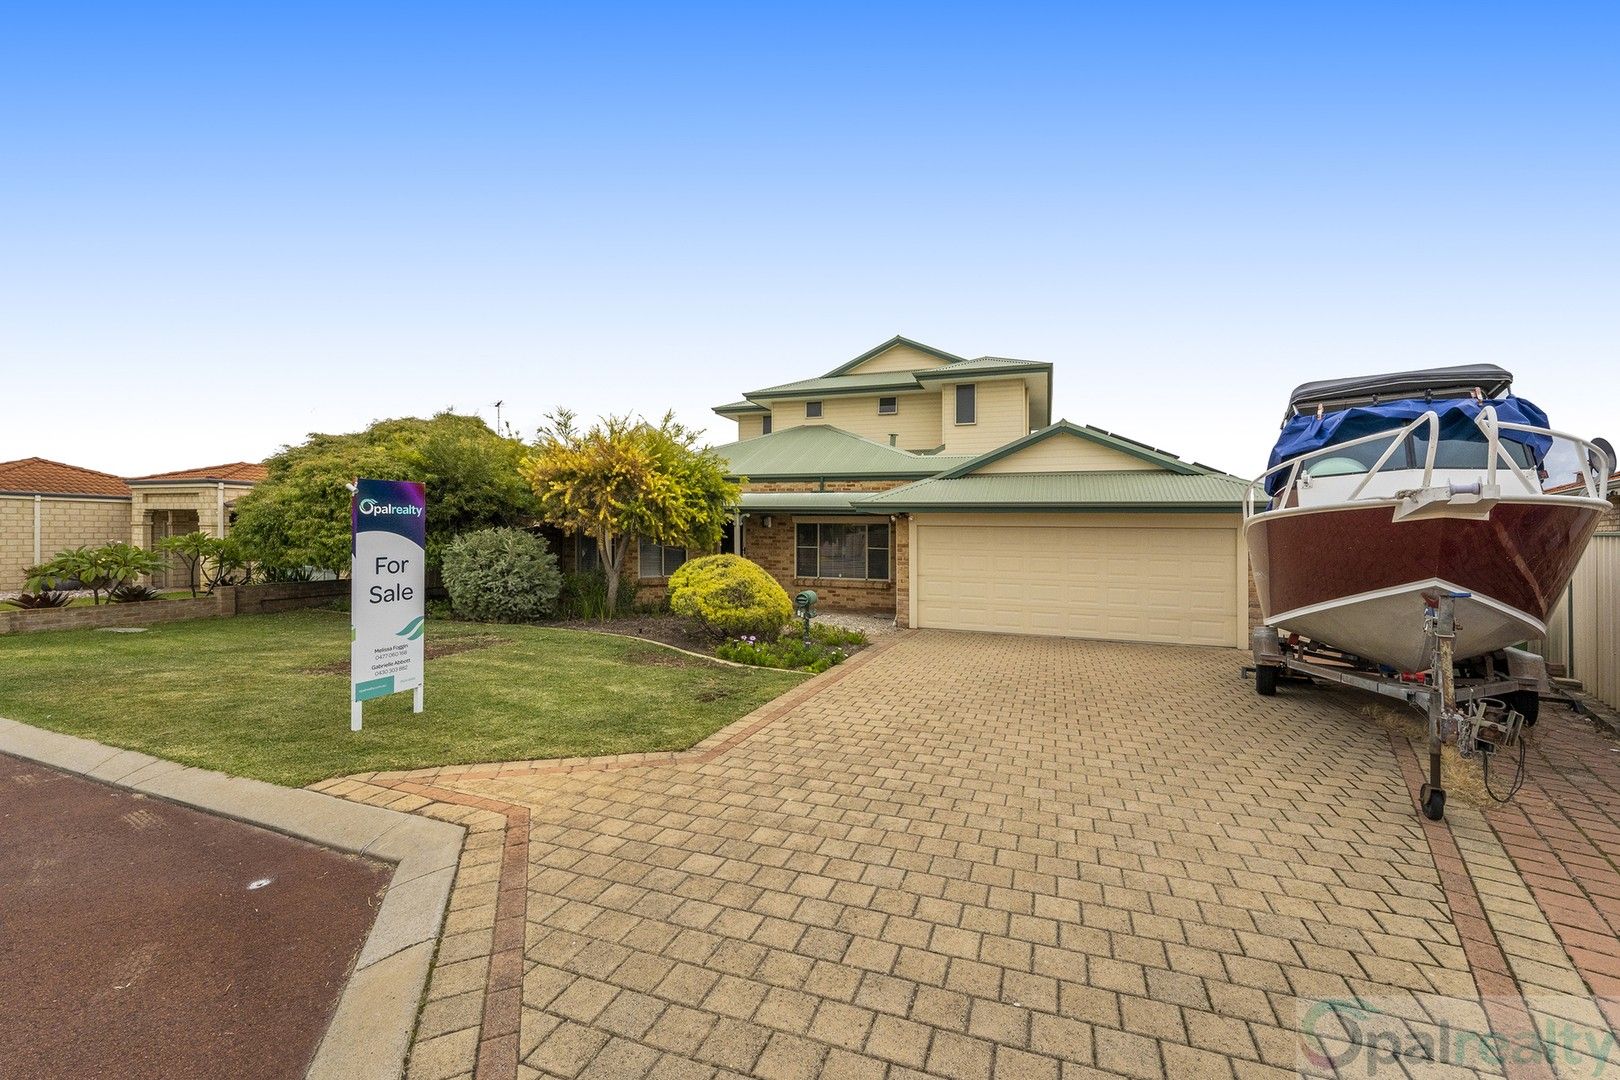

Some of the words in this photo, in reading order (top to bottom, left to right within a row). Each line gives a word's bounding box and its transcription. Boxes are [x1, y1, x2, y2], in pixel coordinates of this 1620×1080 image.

[359, 498, 423, 518] Opalrealty
[376, 556, 409, 575] For
[369, 583, 413, 604] Sale
